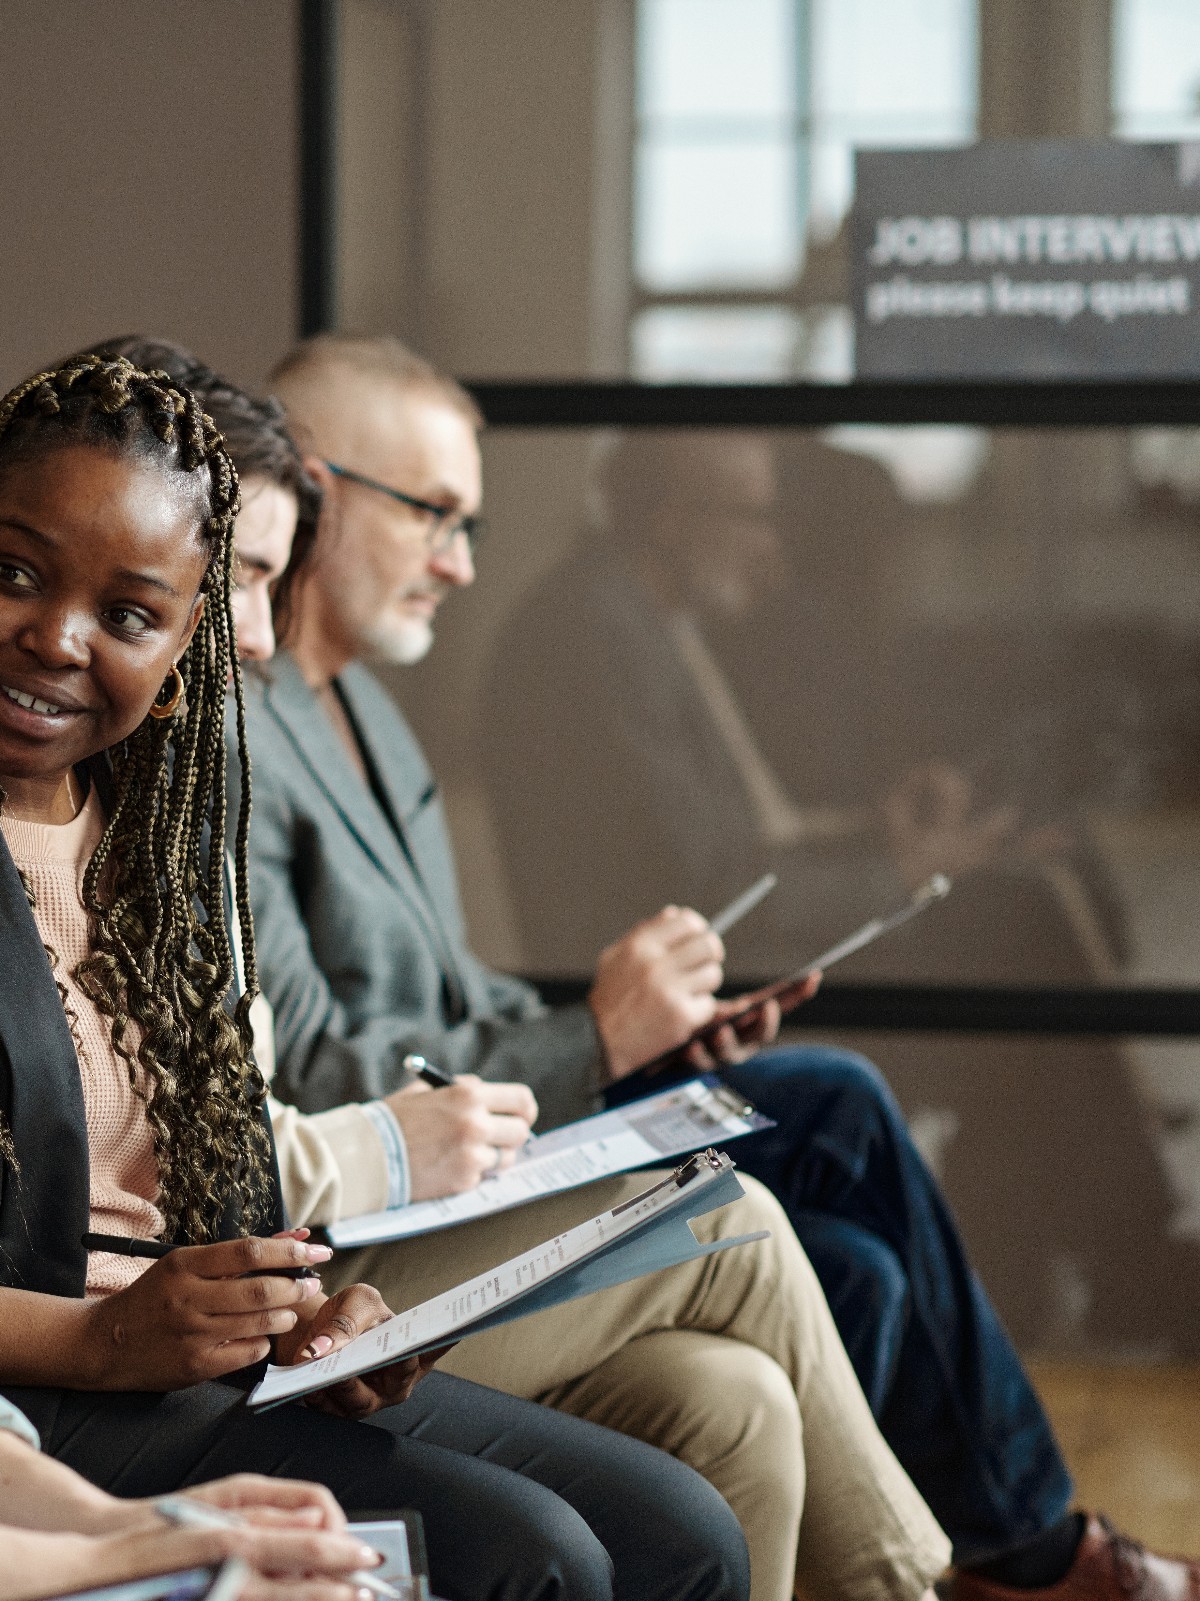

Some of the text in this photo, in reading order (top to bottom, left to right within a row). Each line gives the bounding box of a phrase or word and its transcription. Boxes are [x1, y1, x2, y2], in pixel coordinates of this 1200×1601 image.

[869, 216, 961, 266] JOB
[865, 273, 1188, 323] please keep quiet
